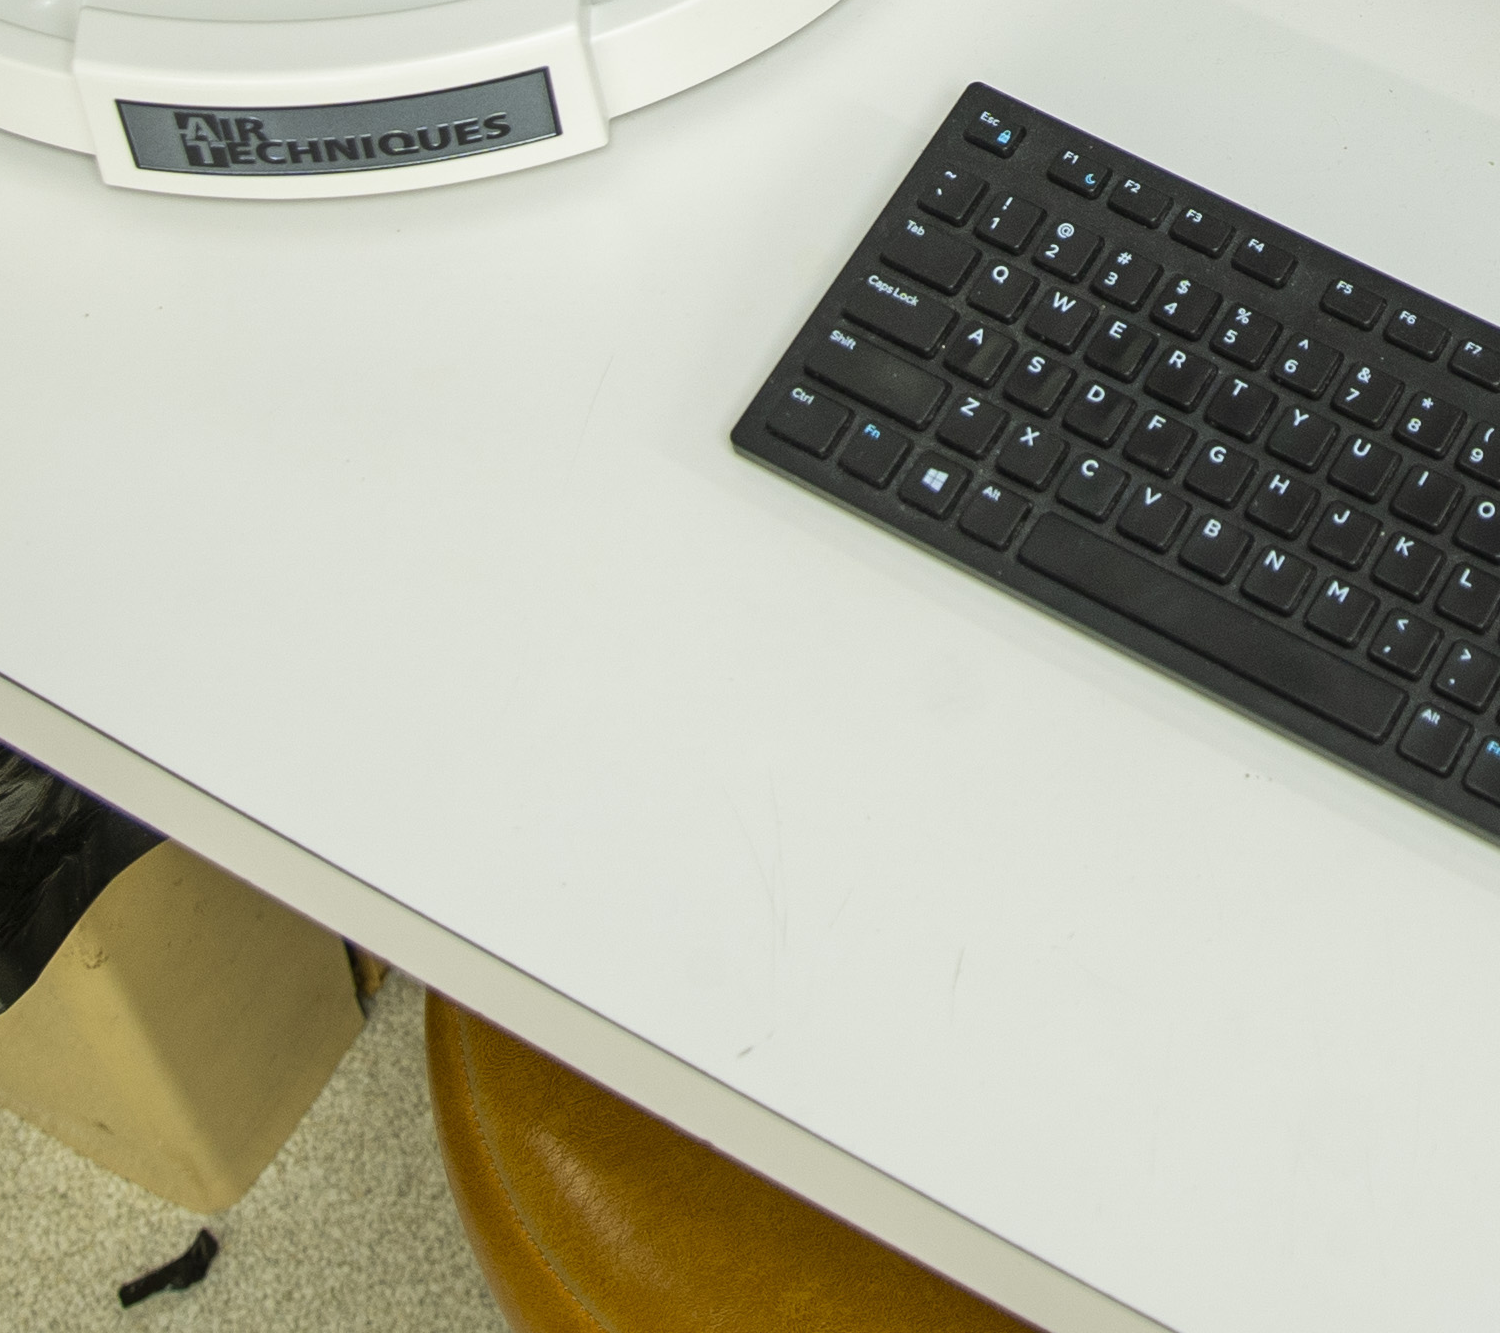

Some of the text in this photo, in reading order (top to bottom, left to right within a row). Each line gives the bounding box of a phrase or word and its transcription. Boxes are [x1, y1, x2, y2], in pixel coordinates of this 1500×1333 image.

[980, 111, 1000, 127] Esc
[186, 111, 512, 168] TECHNIQUES
[1064, 150, 1079, 165] F1
[1124, 179, 1141, 193] F2
[1186, 209, 1202, 223] F3
[906, 220, 925, 236] Tab
[1248, 238, 1265, 253] F4
[868, 274, 919, 307] Caps Lock
[1336, 281, 1353, 295] F5
[1400, 311, 1417, 325] F6
[829, 330, 857, 350] Shift
[1465, 341, 1482, 356] F7
[792, 388, 814, 405] Ctrl
[865, 424, 881, 439] Fn
[982, 485, 1001, 501] Alt
[1421, 709, 1440, 724] Alt
